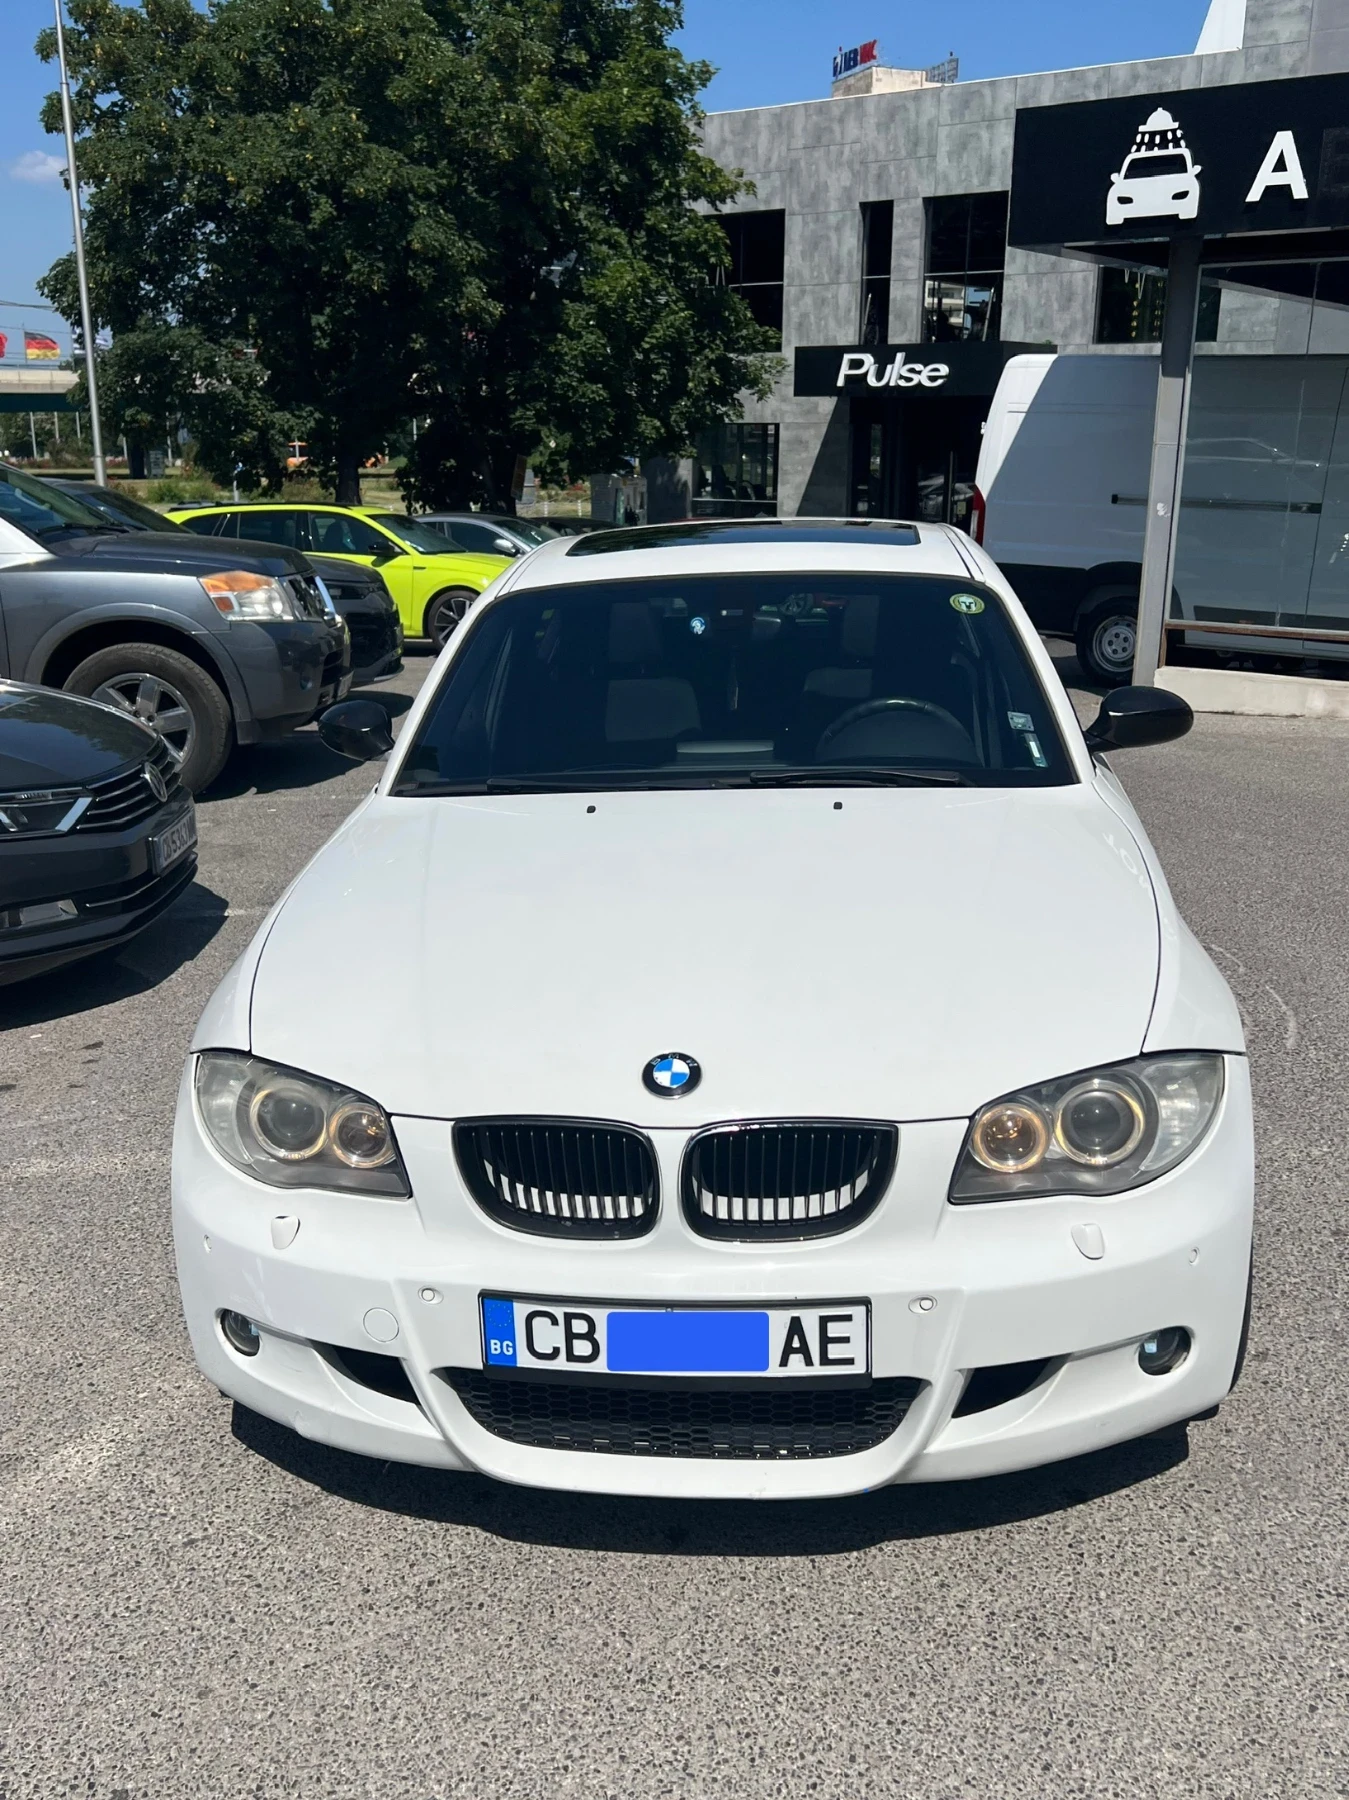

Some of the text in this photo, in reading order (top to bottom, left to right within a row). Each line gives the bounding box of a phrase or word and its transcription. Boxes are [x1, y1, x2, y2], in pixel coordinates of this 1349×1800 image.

[836, 351, 949, 388] Pulse
[490, 1339, 514, 1356] BG
[524, 1309, 855, 1368] CB AE
